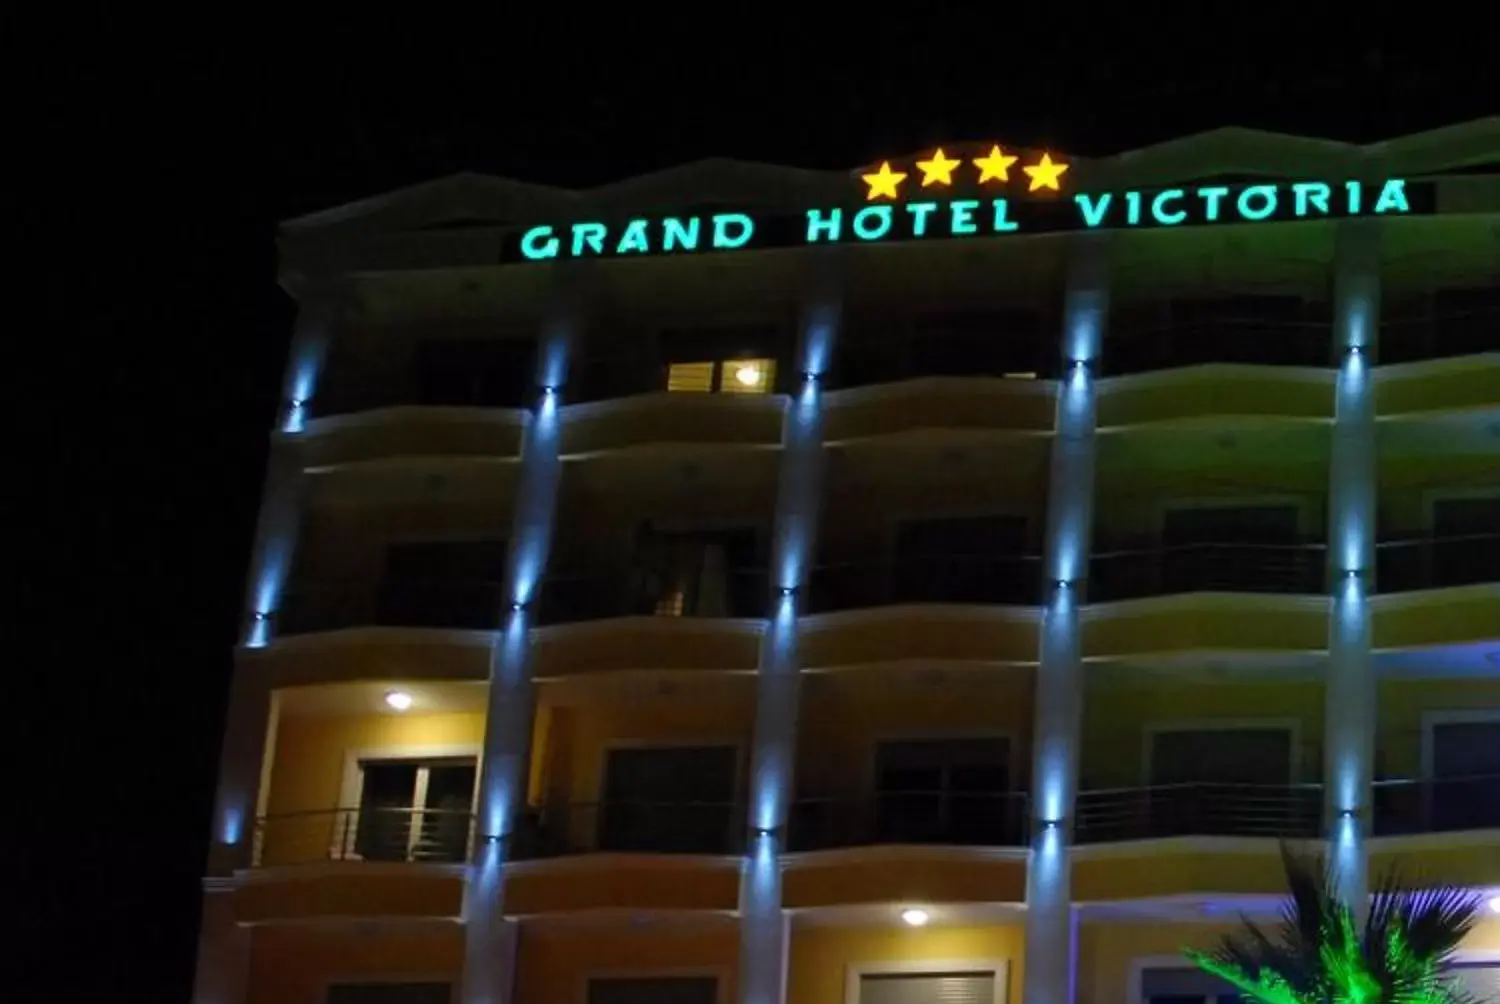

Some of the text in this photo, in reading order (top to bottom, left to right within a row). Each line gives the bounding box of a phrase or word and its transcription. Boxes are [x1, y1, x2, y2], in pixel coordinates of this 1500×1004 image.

[520, 178, 1411, 261] GRAND HOTEL VICTORIA
